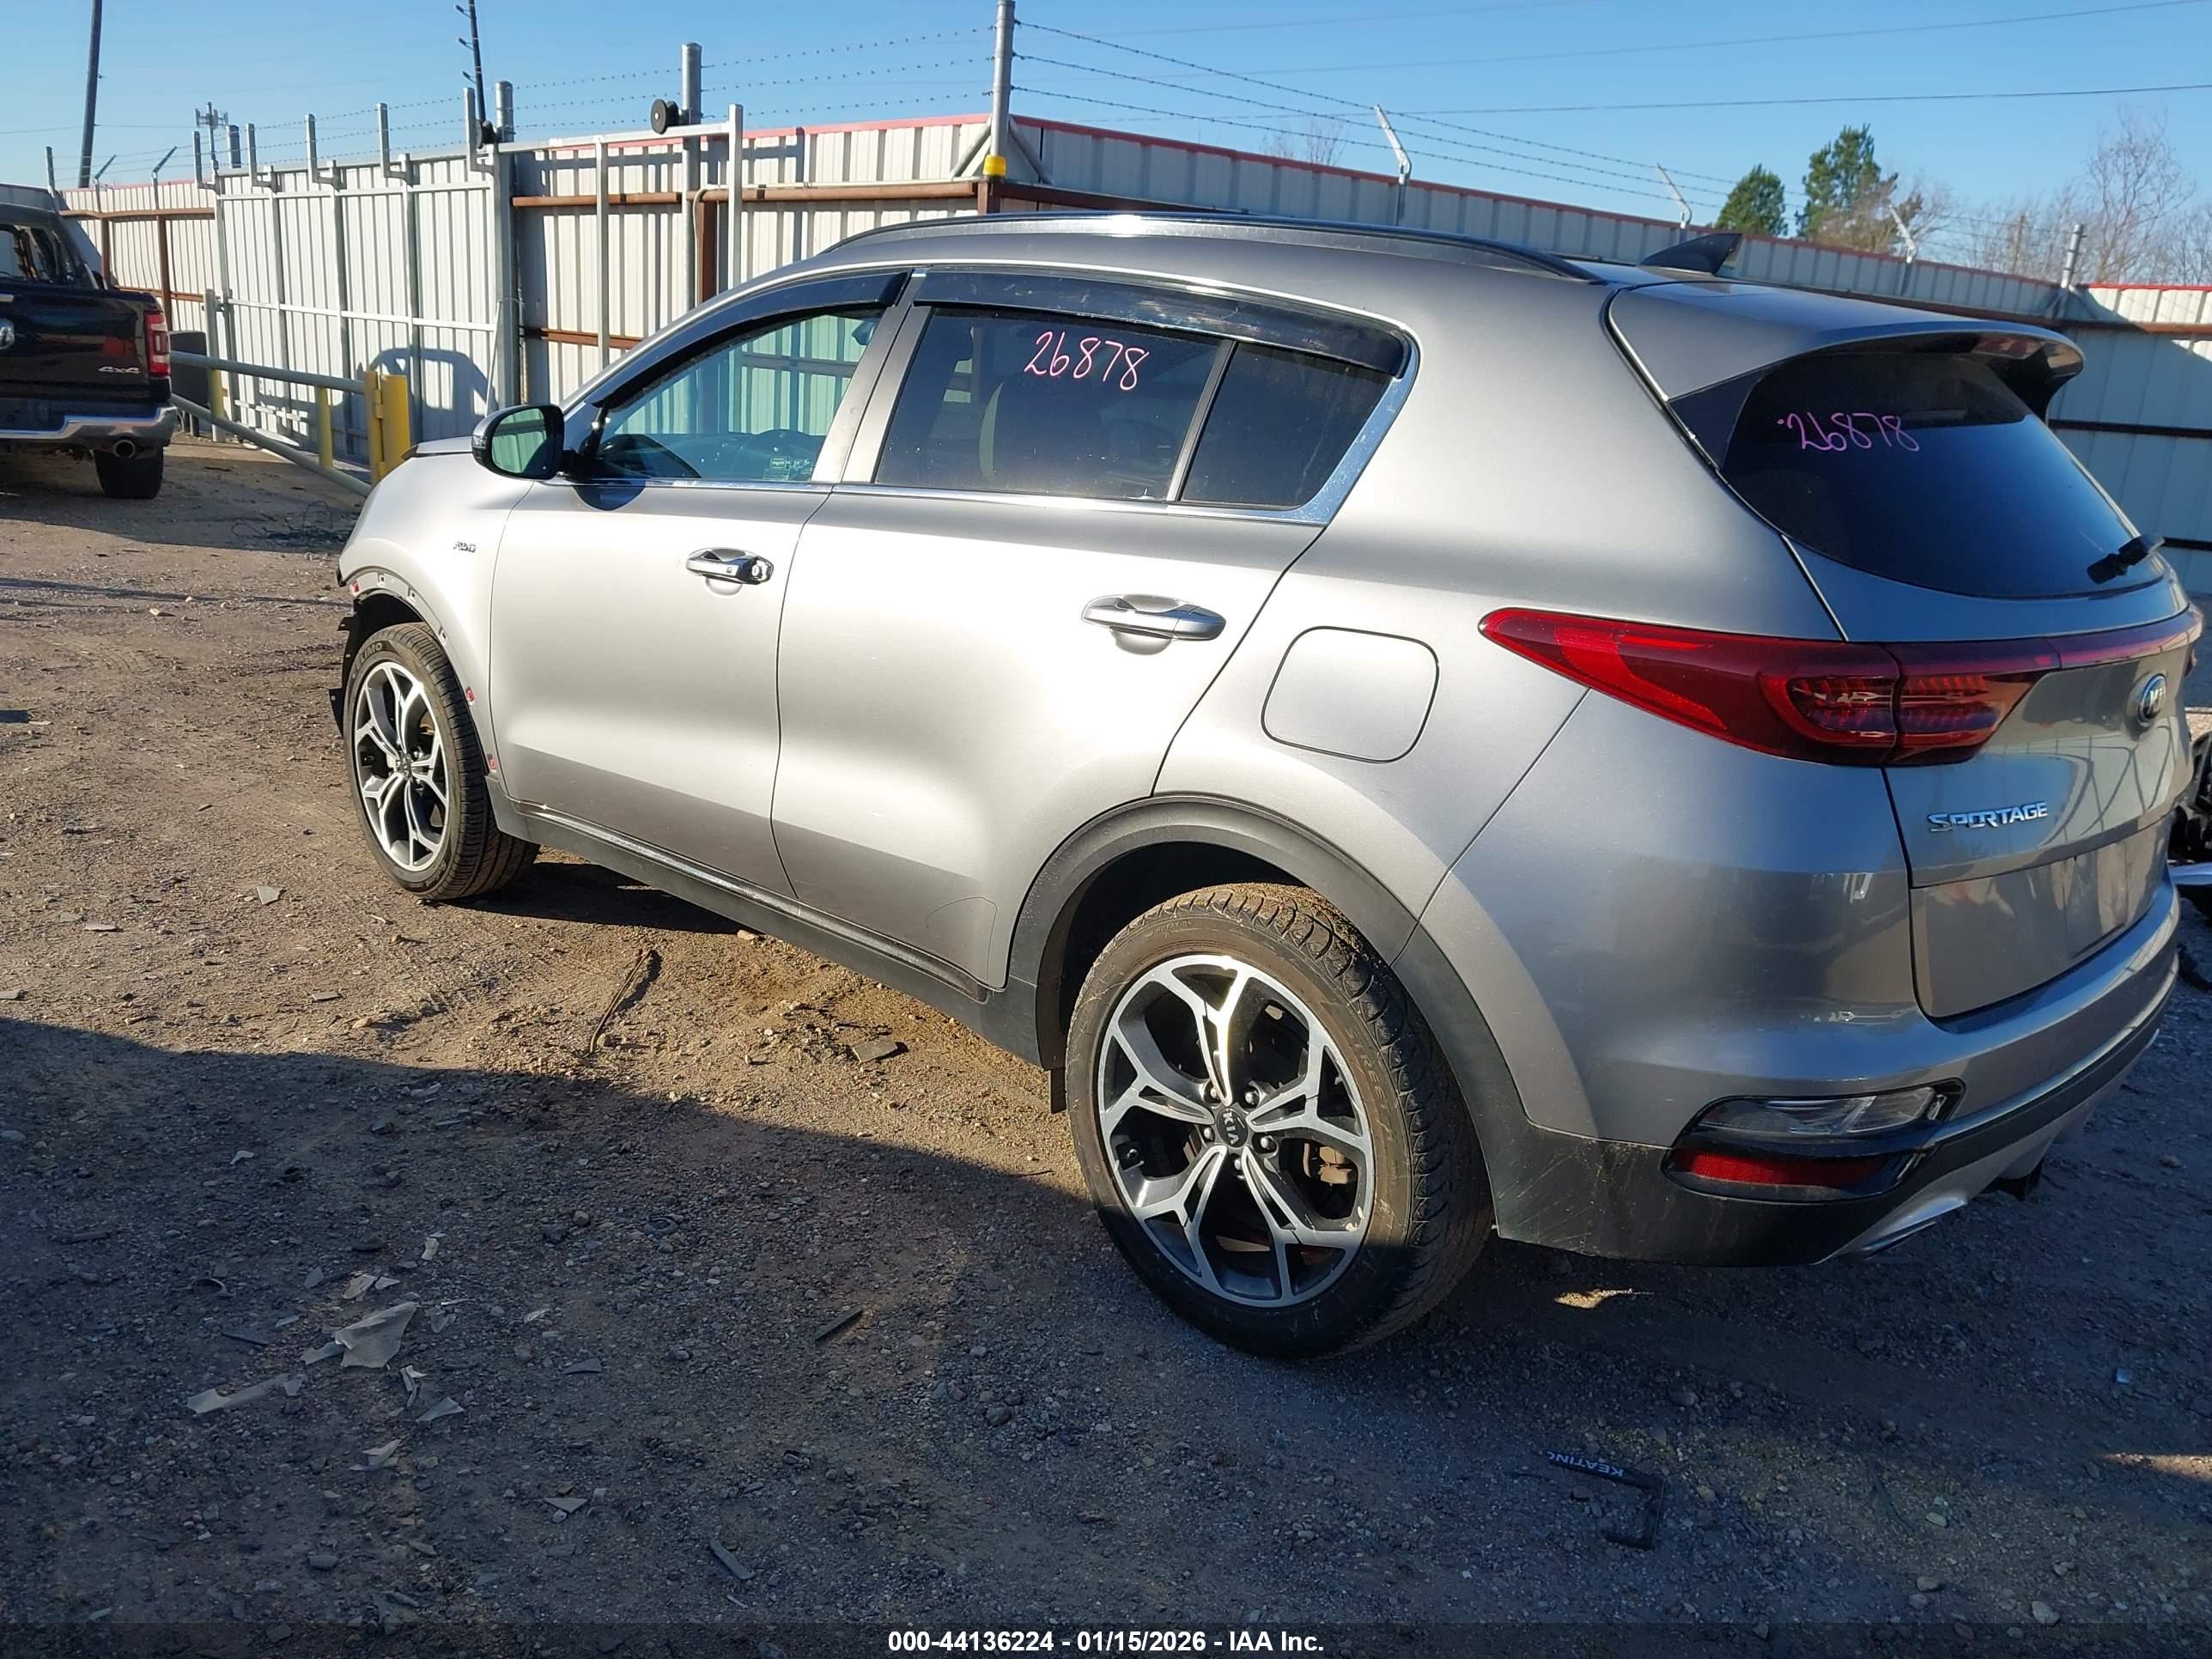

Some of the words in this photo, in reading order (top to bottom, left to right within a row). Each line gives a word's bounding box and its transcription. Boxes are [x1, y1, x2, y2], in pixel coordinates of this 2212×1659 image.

[1024, 330, 1150, 391] 26878
[1786, 411, 1920, 452] 26878
[1928, 801, 2048, 832] SPORTAGE
[1222, 1111, 1239, 1146] KIA
